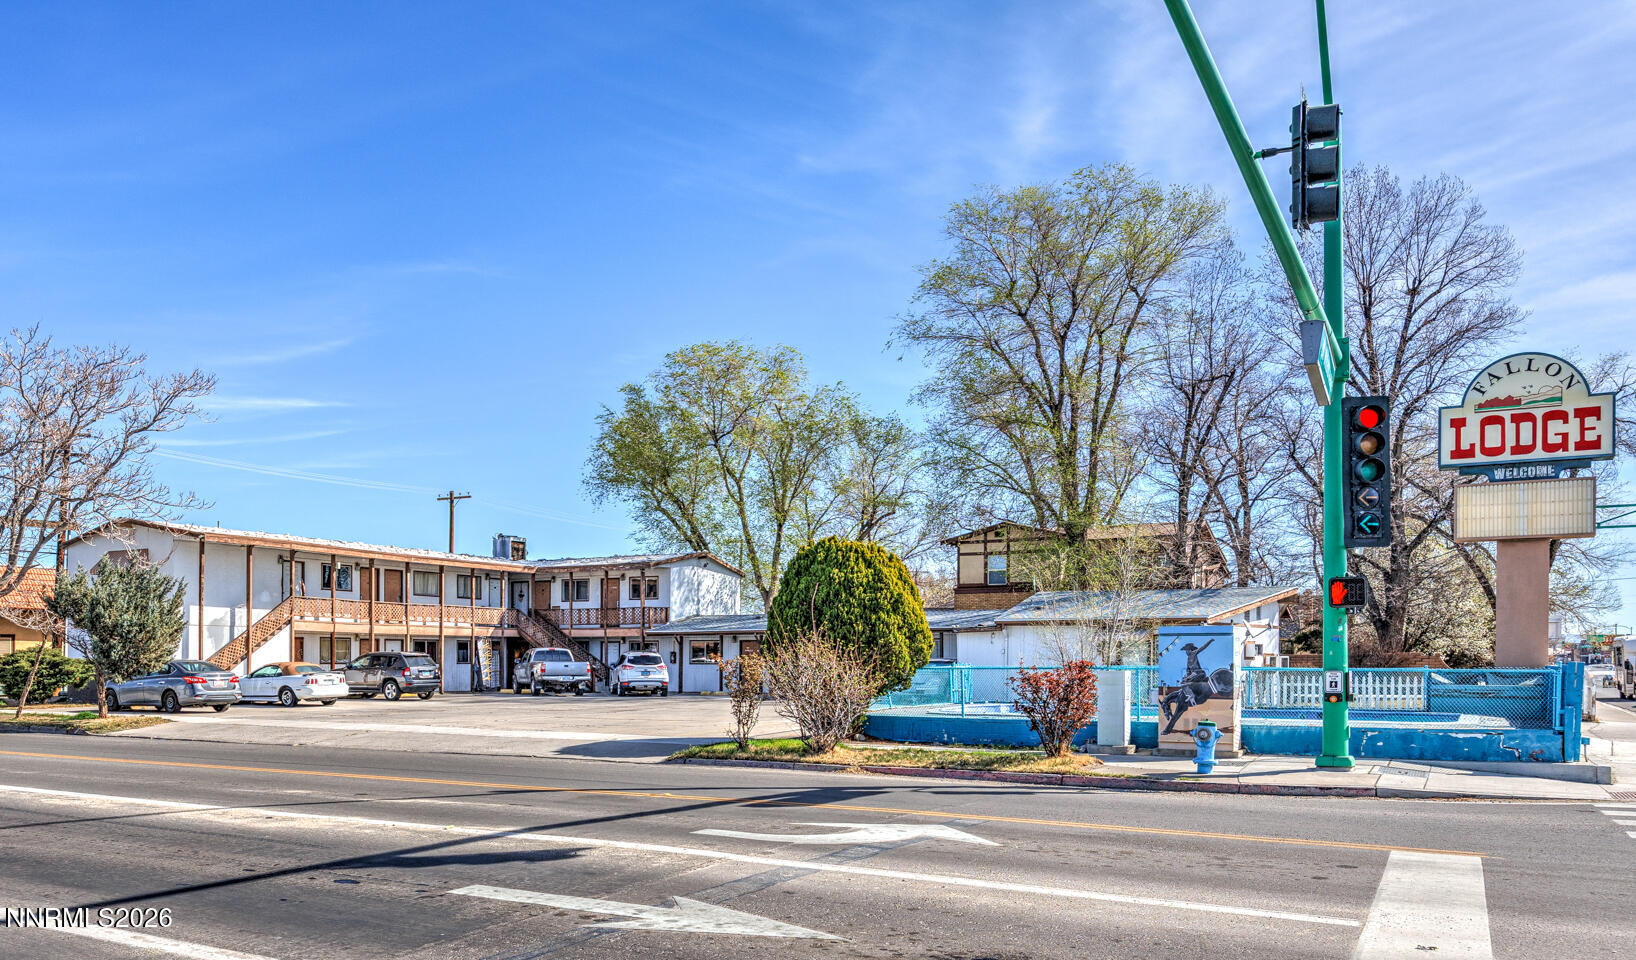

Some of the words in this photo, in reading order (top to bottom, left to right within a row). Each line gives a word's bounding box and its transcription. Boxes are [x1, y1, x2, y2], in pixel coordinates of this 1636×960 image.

[1472, 358, 1581, 396] FALLON
[1450, 406, 1601, 459] LODGE
[1494, 465, 1555, 479] WELCOME
